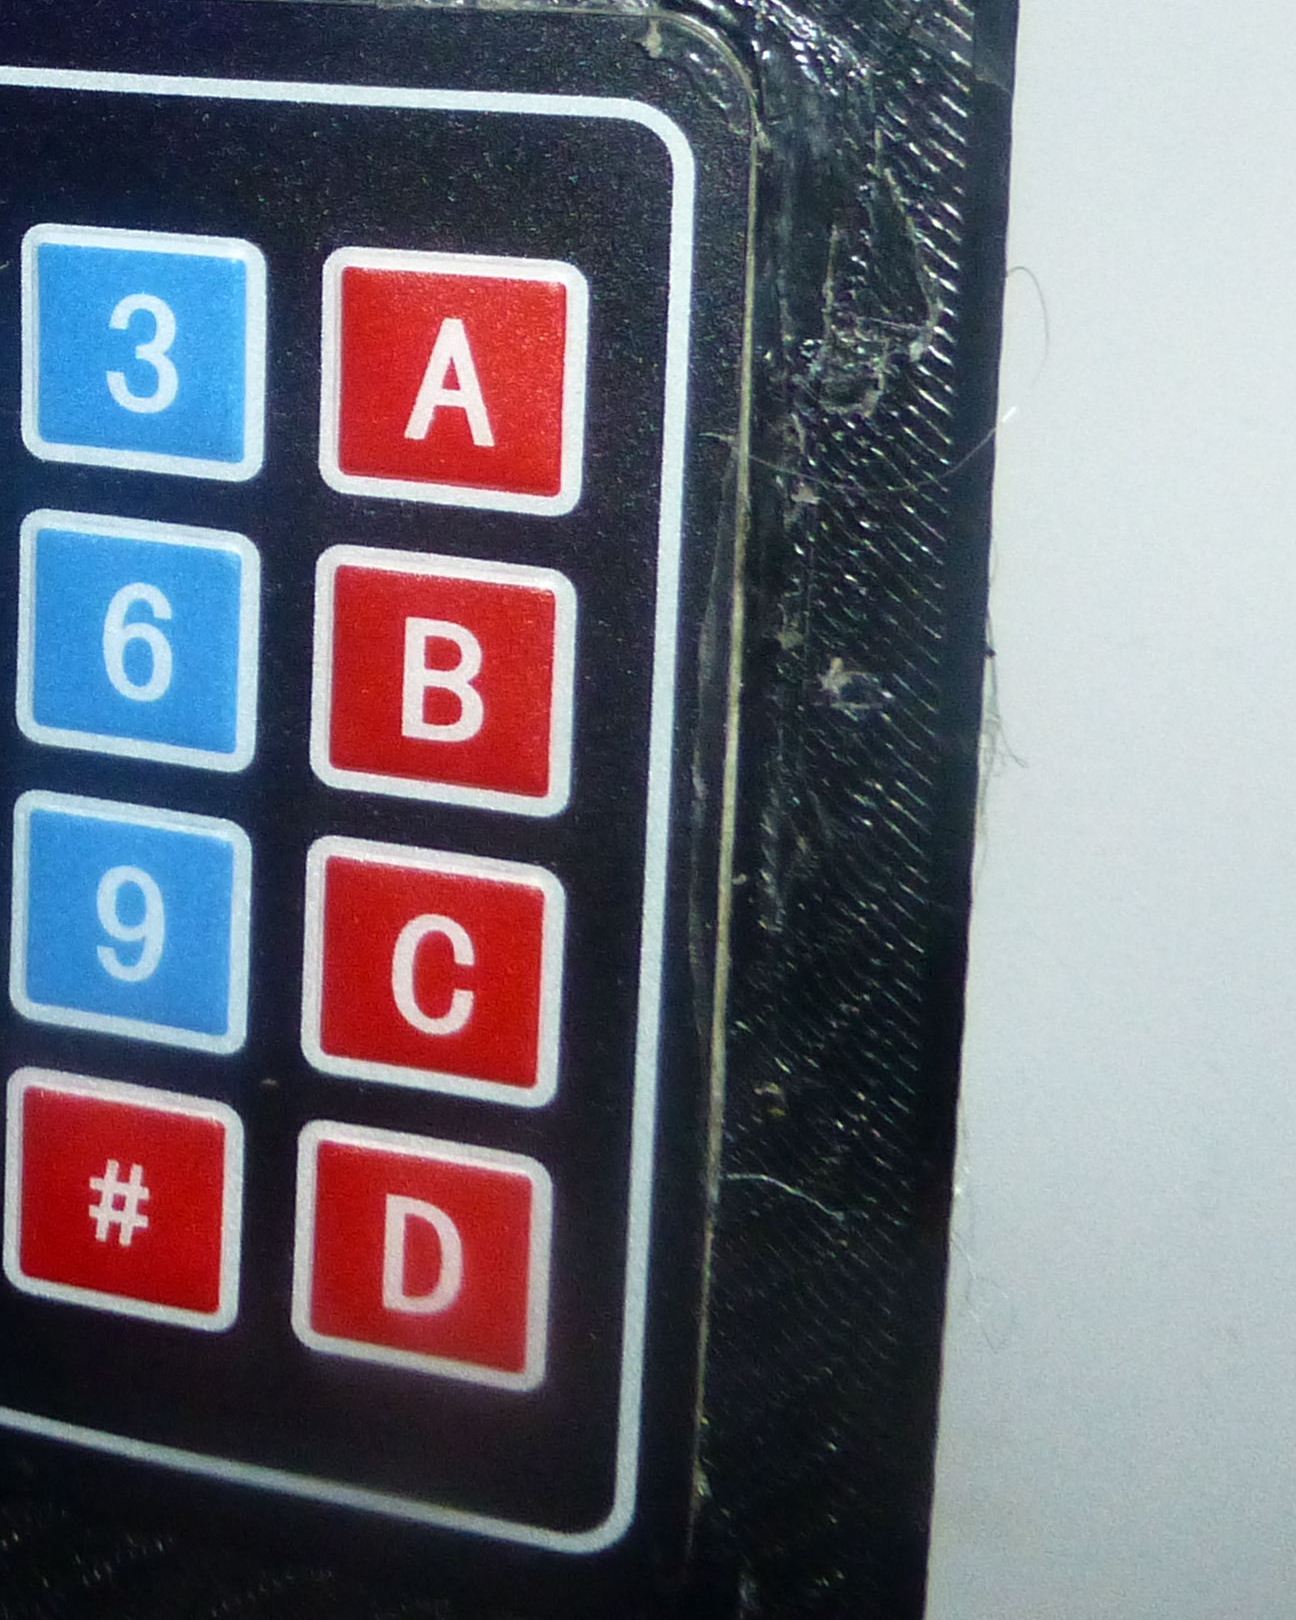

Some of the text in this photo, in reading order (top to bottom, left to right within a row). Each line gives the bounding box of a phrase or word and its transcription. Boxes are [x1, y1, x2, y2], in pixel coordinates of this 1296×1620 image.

[106, 292, 179, 414] 3
[404, 317, 495, 447] A
[102, 582, 173, 702] 6
[401, 616, 485, 743] B
[93, 865, 166, 983] 9
[389, 913, 475, 1036] C
[89, 1159, 150, 1246] #
[382, 1193, 463, 1314] D
